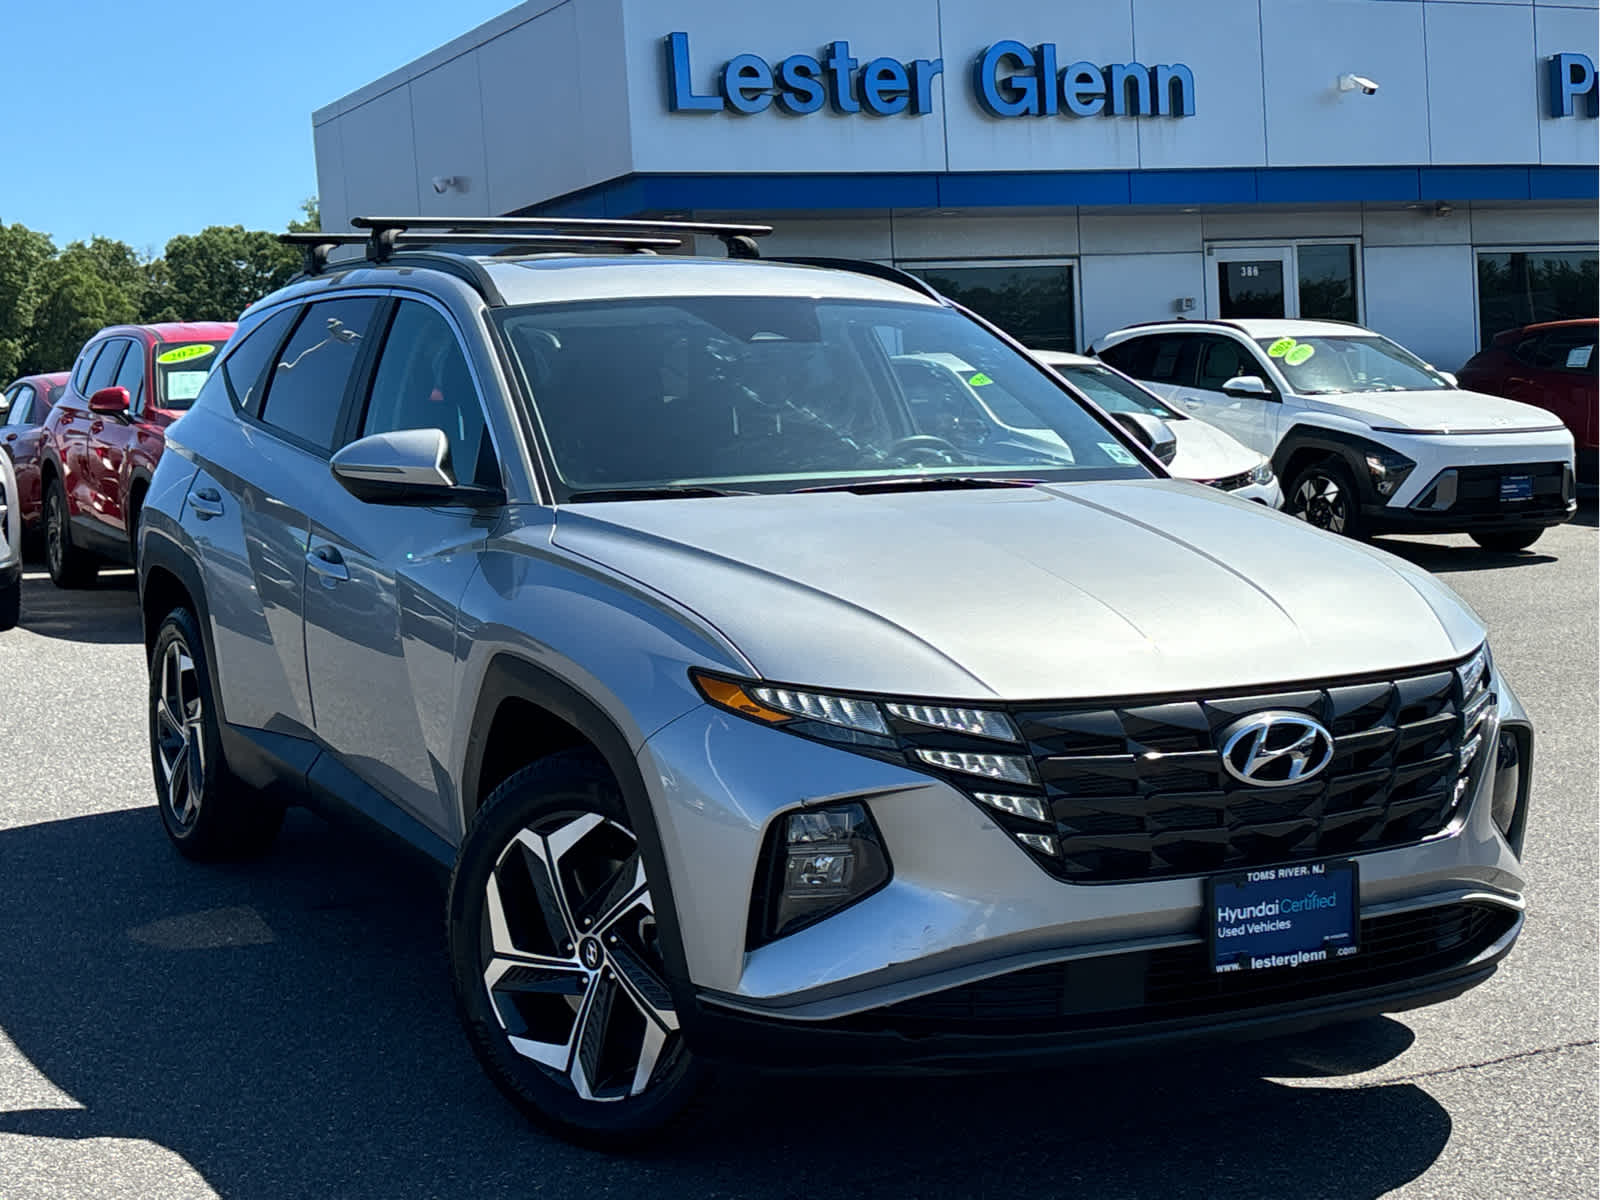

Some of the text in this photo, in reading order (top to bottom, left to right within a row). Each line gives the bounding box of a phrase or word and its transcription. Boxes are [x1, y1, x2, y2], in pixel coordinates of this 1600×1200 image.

[666, 31, 1196, 118] Lester Glenn
[1551, 53, 1599, 117] P
[170, 346, 206, 361] 2022
[1247, 869, 1276, 882] TOMS
[1312, 864, 1325, 875] NJ
[1217, 890, 1337, 924] Hyundai Certified
[1217, 919, 1292, 938] Used Vehicles
[1251, 950, 1327, 969] lesterglenn
